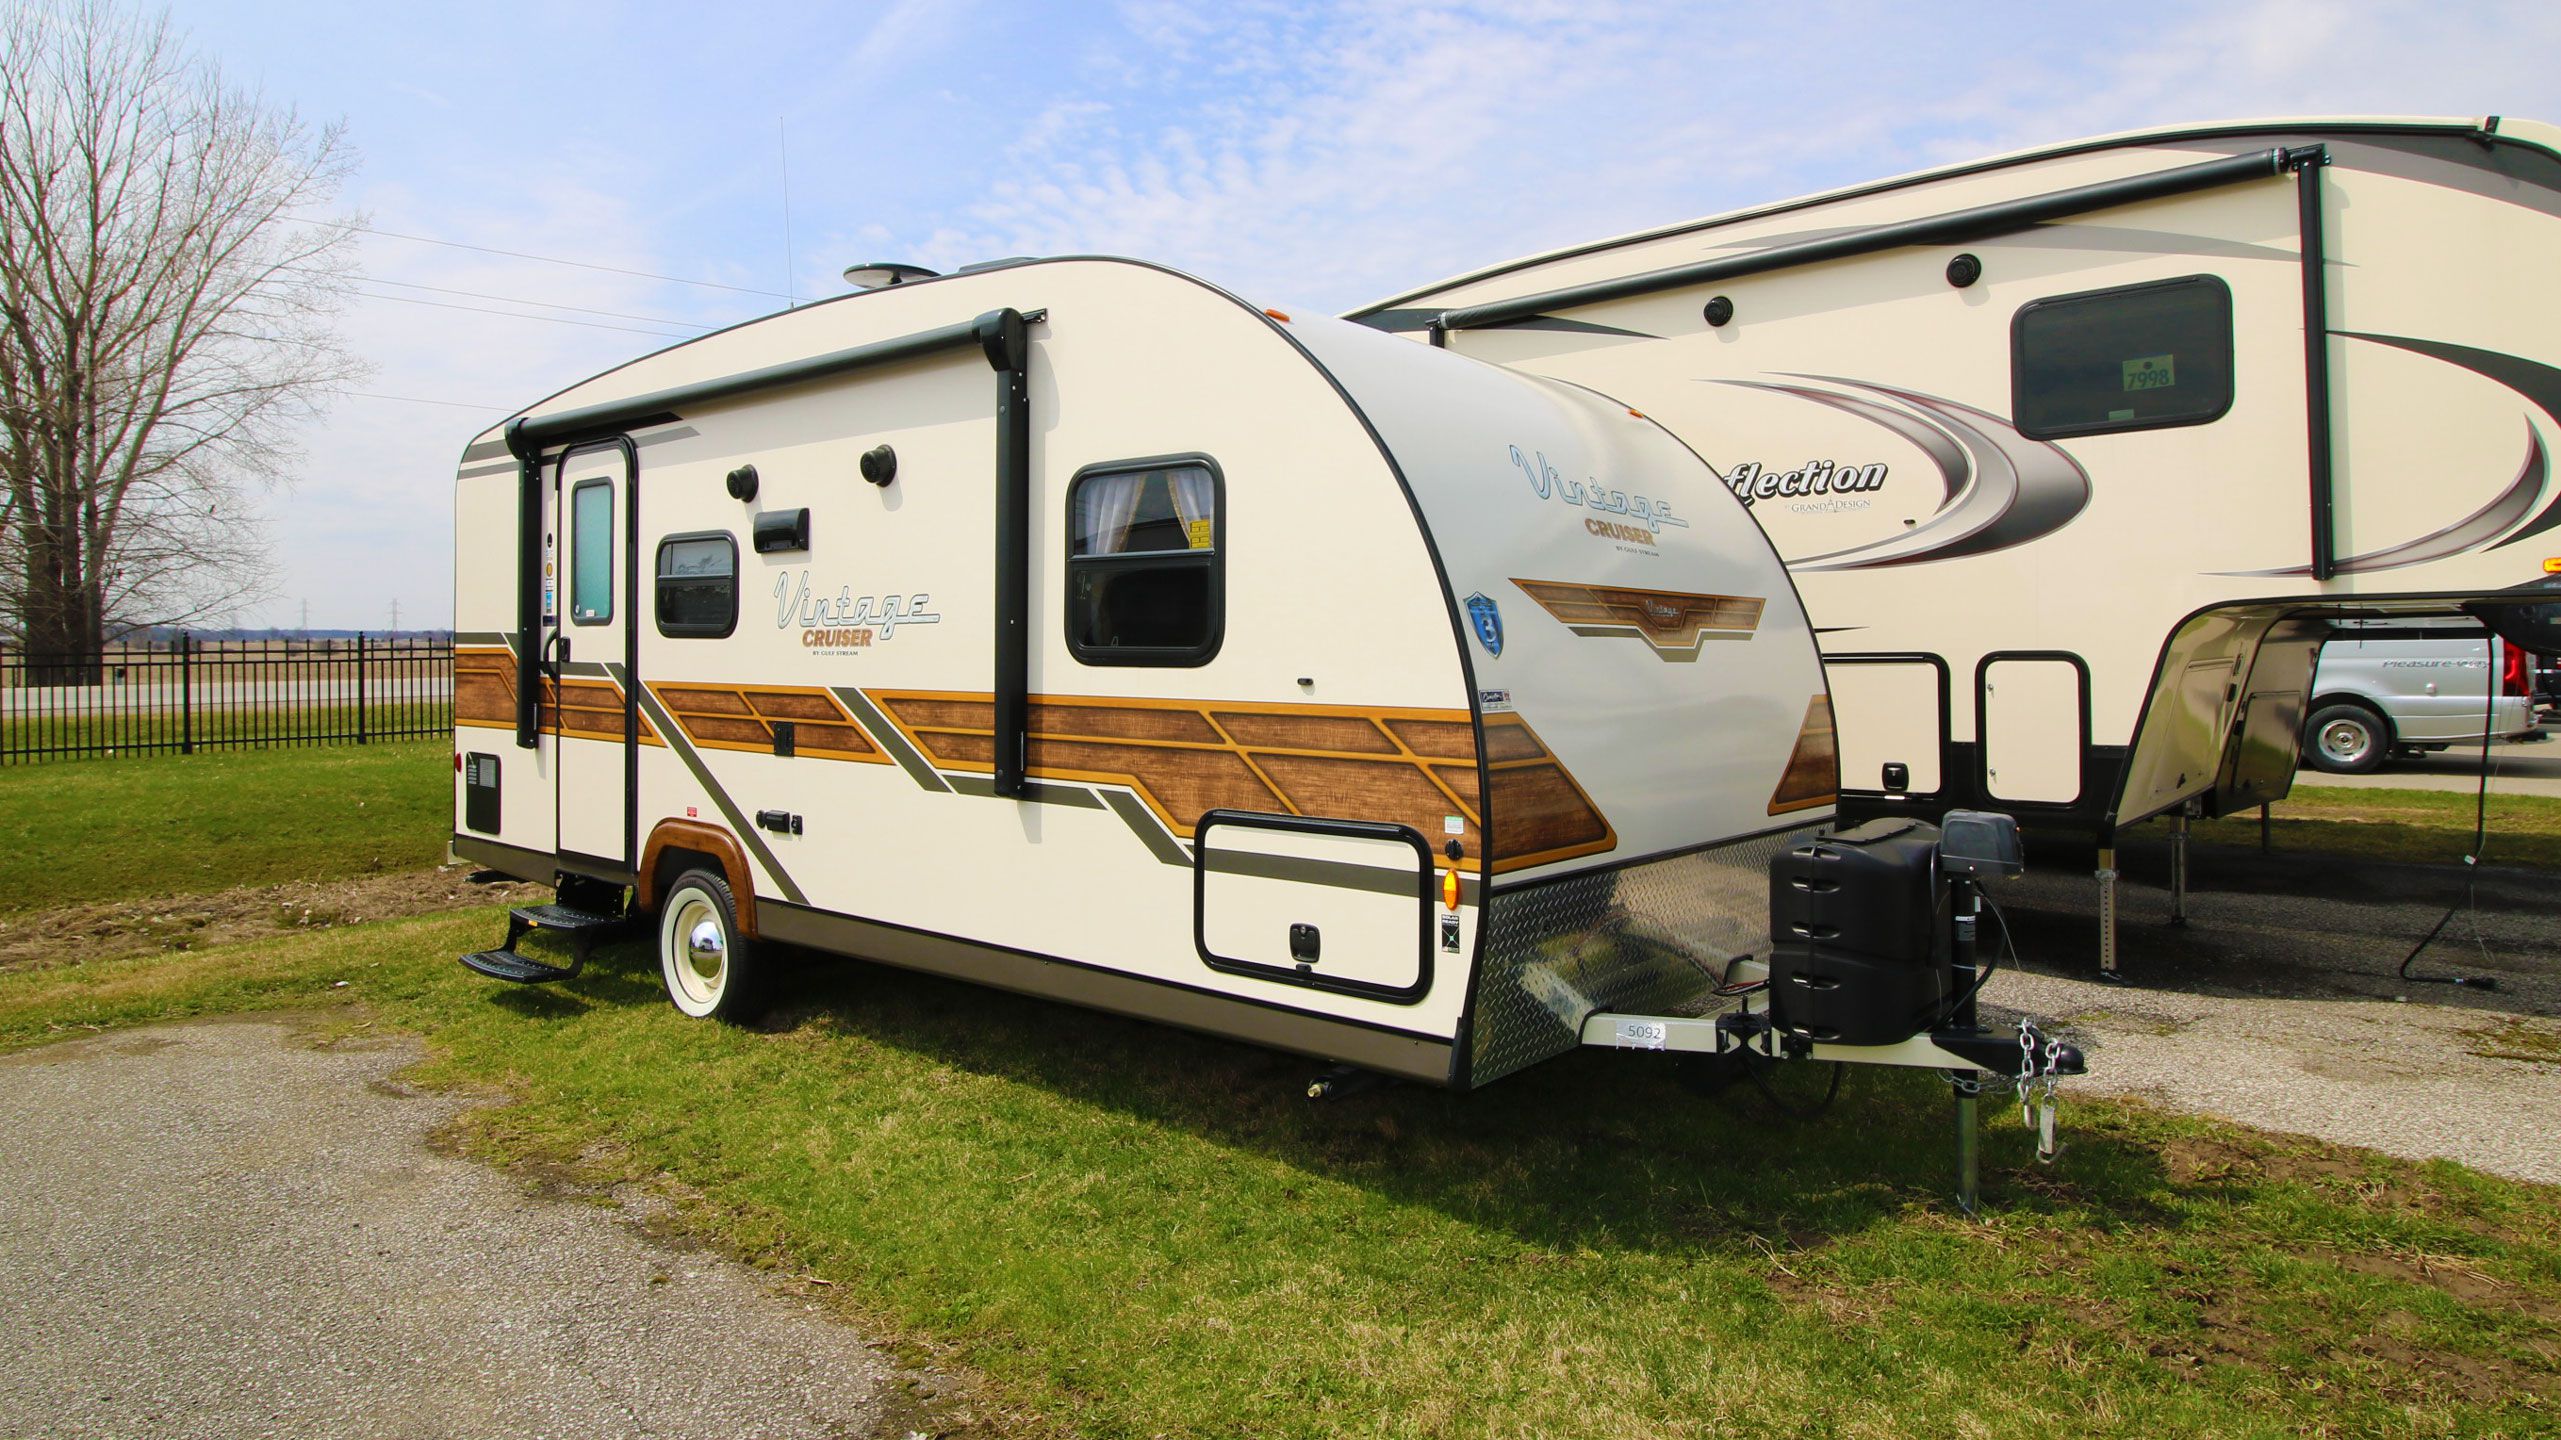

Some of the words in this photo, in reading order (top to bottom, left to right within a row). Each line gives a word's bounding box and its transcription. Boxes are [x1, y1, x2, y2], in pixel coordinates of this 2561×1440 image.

[2127, 369, 2169, 389] 7998
[1509, 444, 1689, 534] Vintage
[1723, 460, 1888, 507] flection
[1791, 502, 1826, 513] GRAND
[1835, 499, 1871, 509] DESIGN
[1584, 518, 1656, 547] CRUISER
[773, 570, 941, 640] Vintage
[802, 628, 873, 647] CRUISER
[1482, 618, 1497, 642] 3
[1628, 1025, 1661, 1039] 5092
